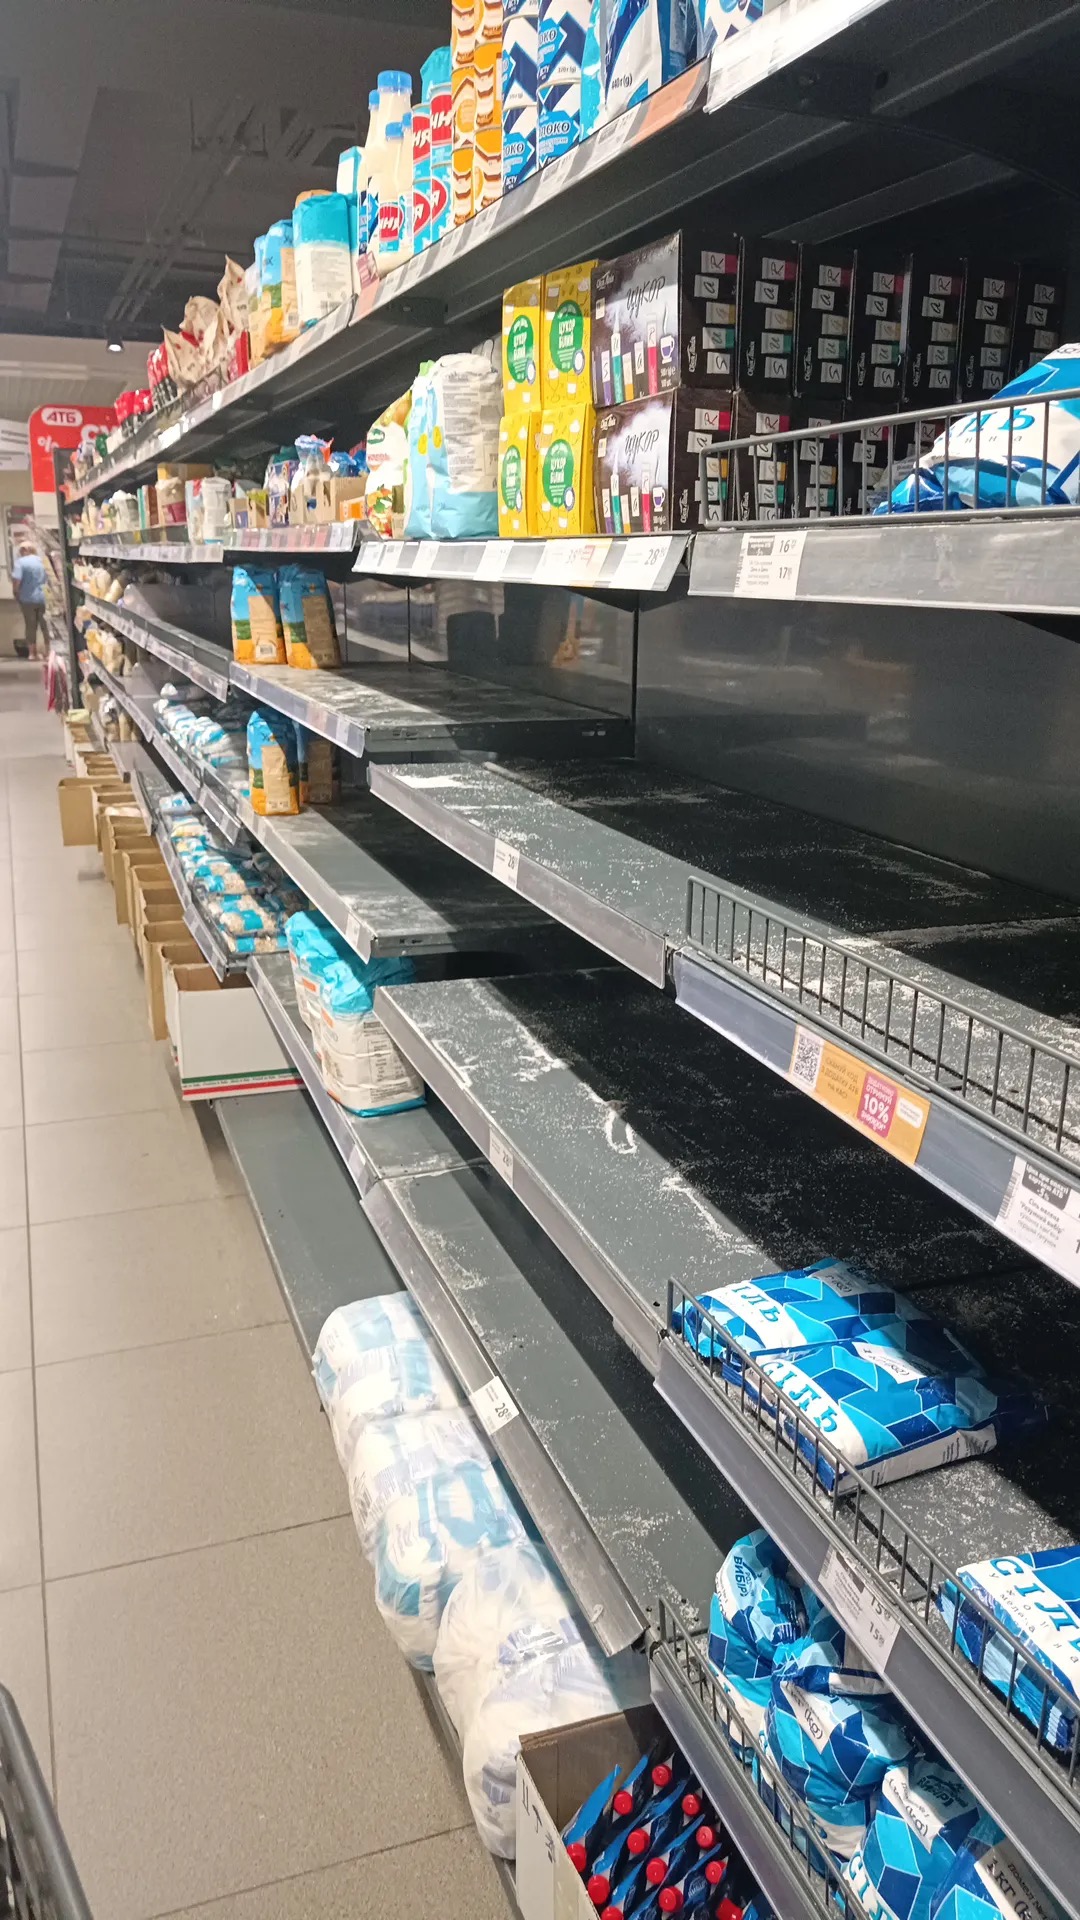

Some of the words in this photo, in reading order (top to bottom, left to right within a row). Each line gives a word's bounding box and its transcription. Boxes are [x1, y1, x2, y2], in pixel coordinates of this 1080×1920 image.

[627, 275, 666, 319] ЦУКОР
[47, 411, 77, 424] АТБ
[779, 539, 790, 553] 16
[863, 1093, 890, 1124] 10%
[732, 1285, 781, 1324] ІЛЬ
[760, 1361, 838, 1433] СІЛЬ
[494, 1402, 509, 1418] 28
[868, 1621, 880, 1640] 15
